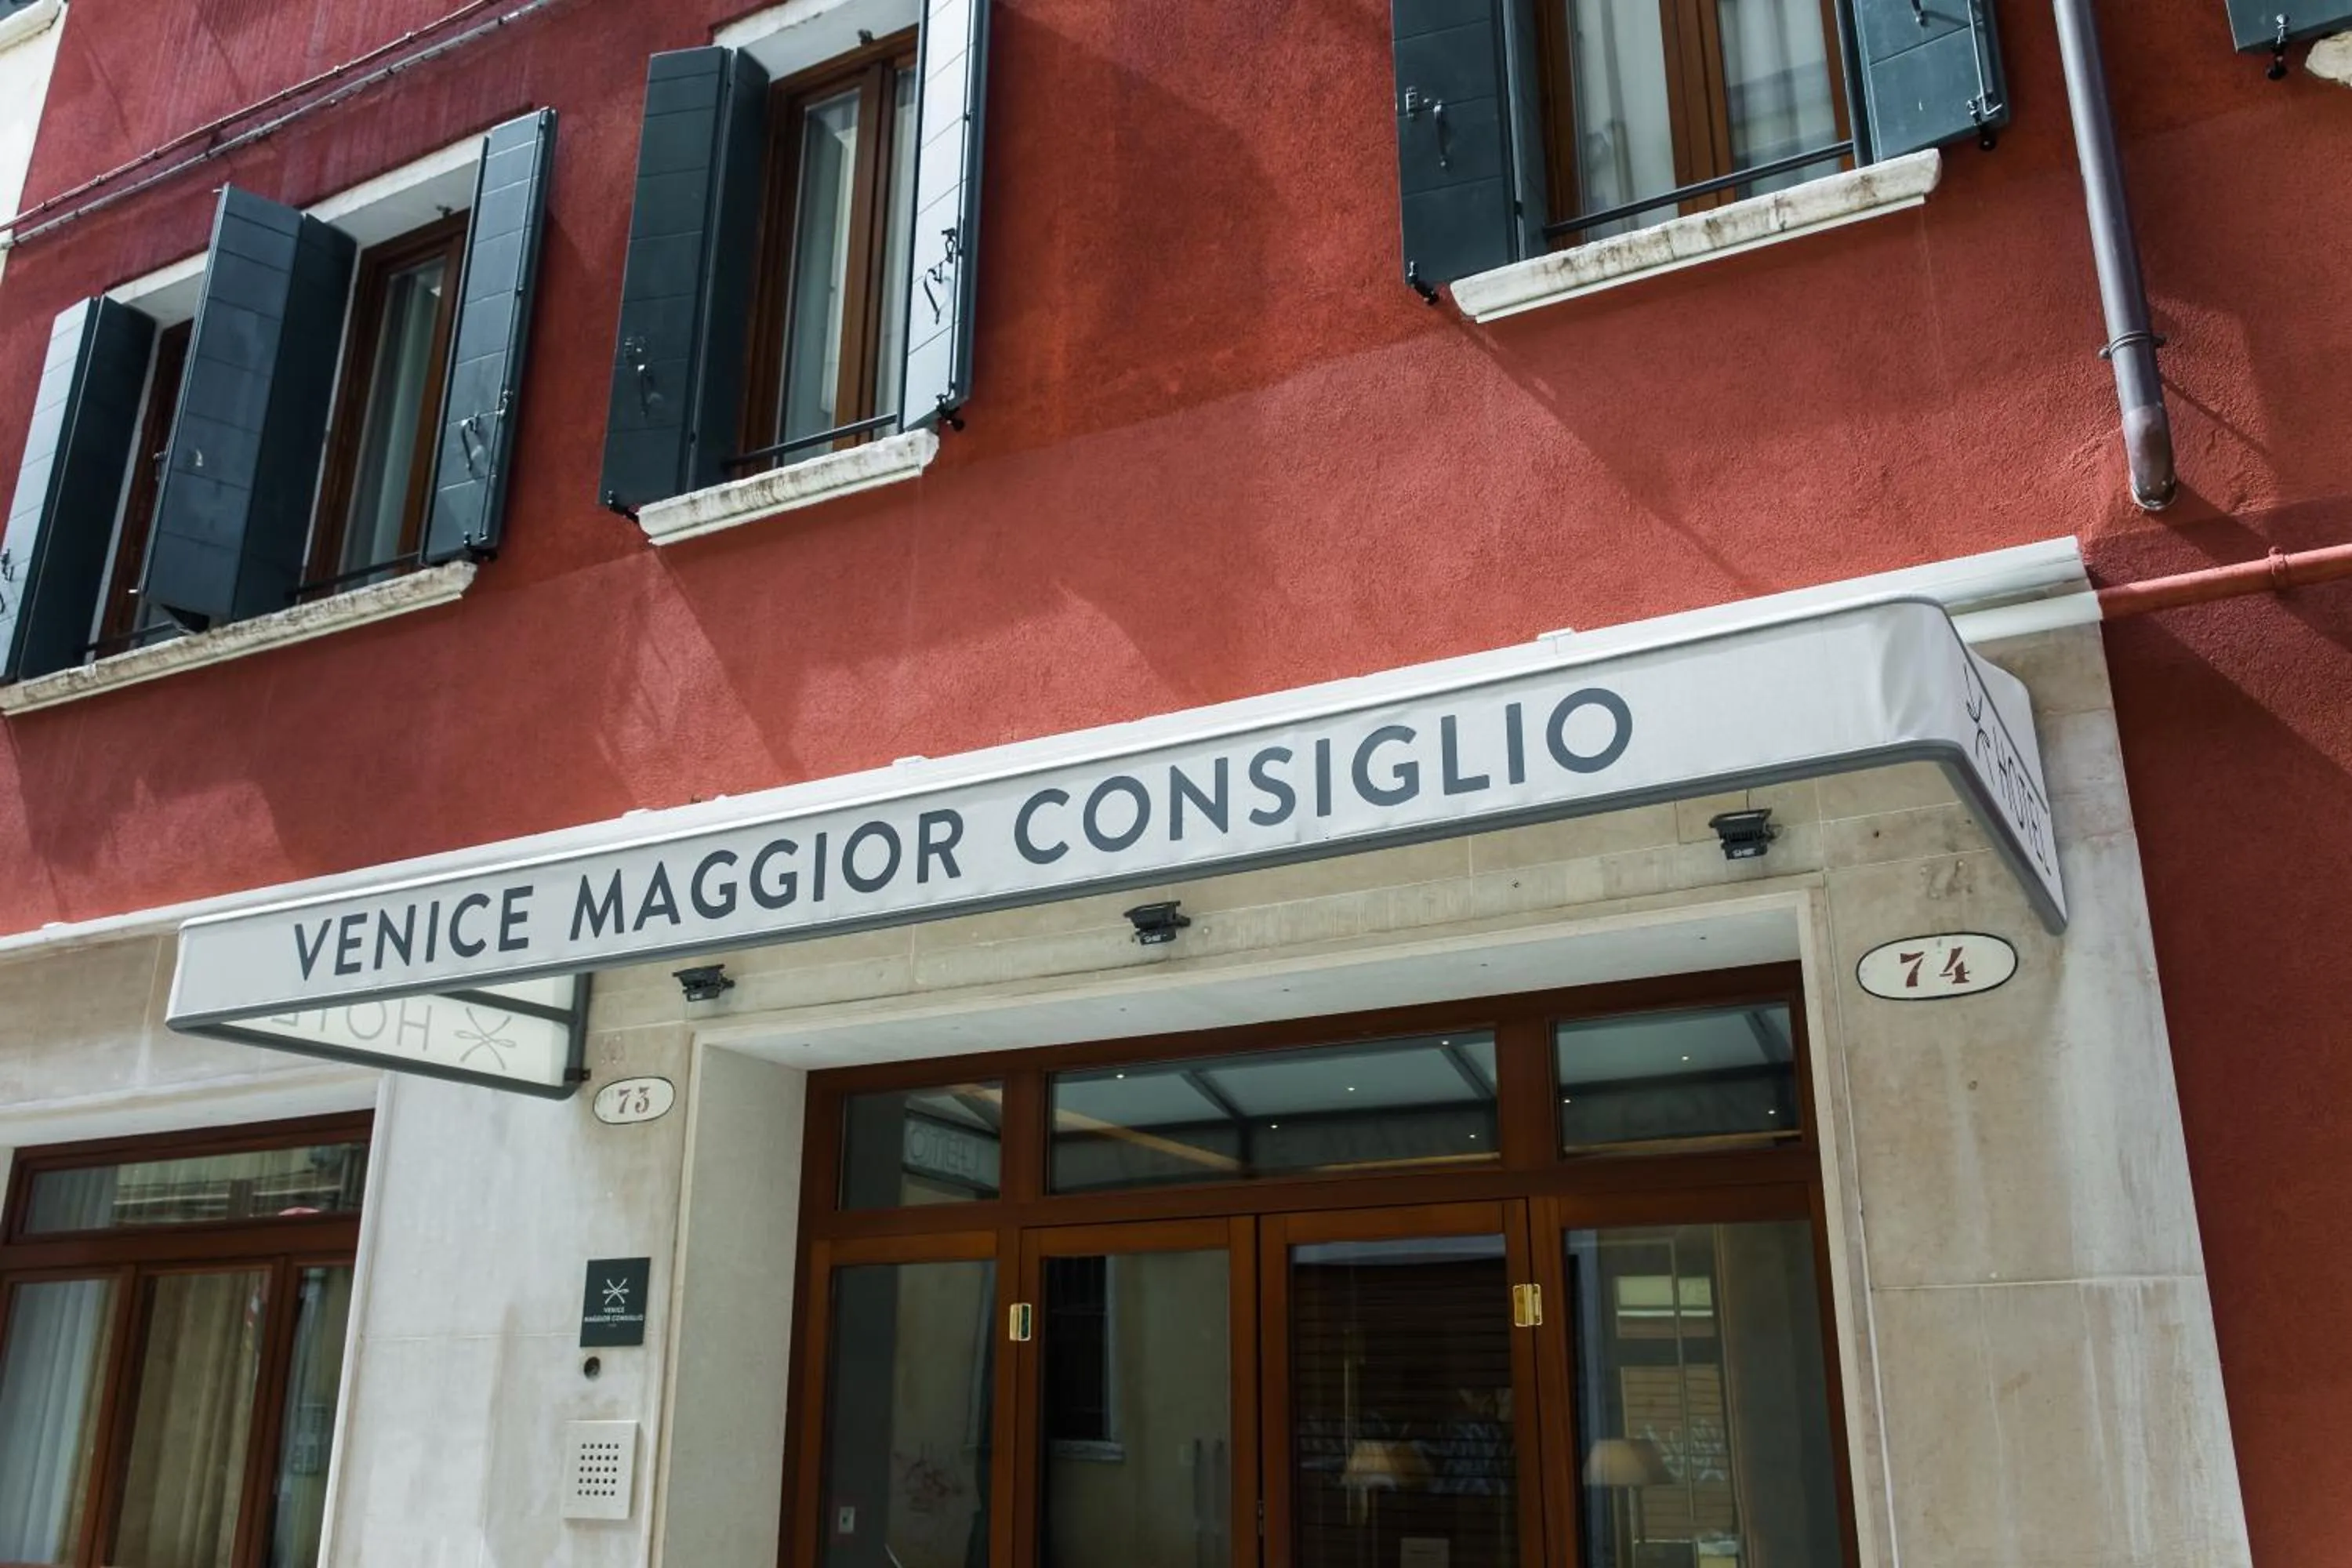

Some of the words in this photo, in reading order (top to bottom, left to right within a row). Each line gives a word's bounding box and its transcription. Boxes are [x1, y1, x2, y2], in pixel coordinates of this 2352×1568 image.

[294, 884, 534, 981] VENICE
[569, 808, 964, 941] MAGGIOR
[1014, 688, 1633, 865] CONSIGLIO
[1992, 724, 2052, 877] HOTEL
[1899, 946, 1970, 988] 74
[618, 1086, 650, 1114] 73
